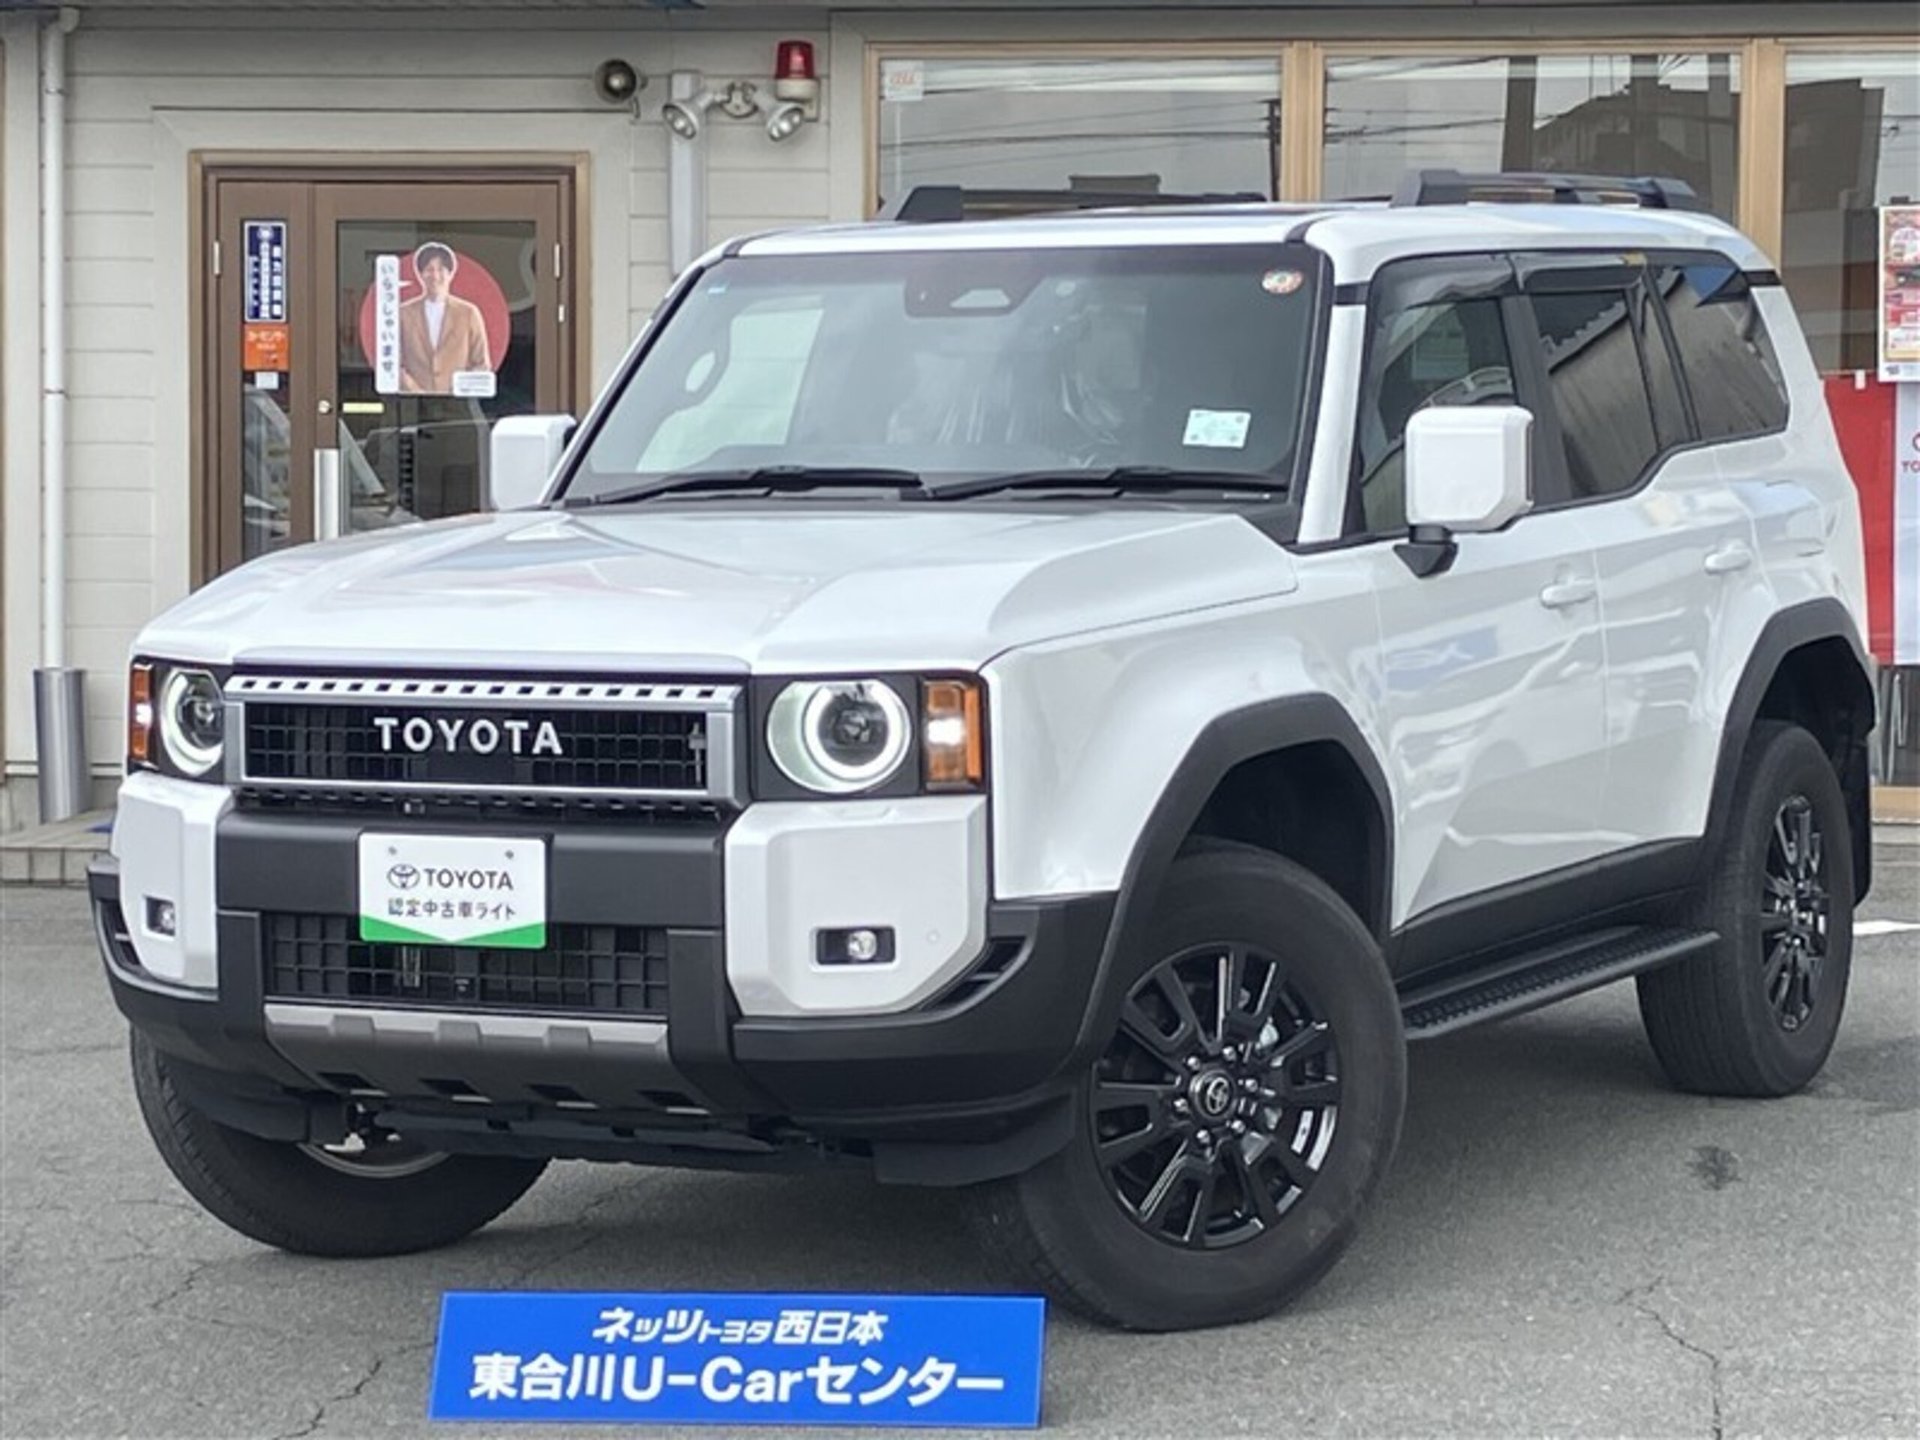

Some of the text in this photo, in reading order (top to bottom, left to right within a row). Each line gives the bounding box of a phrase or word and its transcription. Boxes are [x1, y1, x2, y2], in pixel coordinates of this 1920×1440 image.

[373, 716, 563, 755] TOYOTA
[423, 867, 514, 891] TOYOTA
[387, 897, 516, 920] 認定中古車ライト
[592, 1306, 889, 1346] ネッツトヨタ西日本
